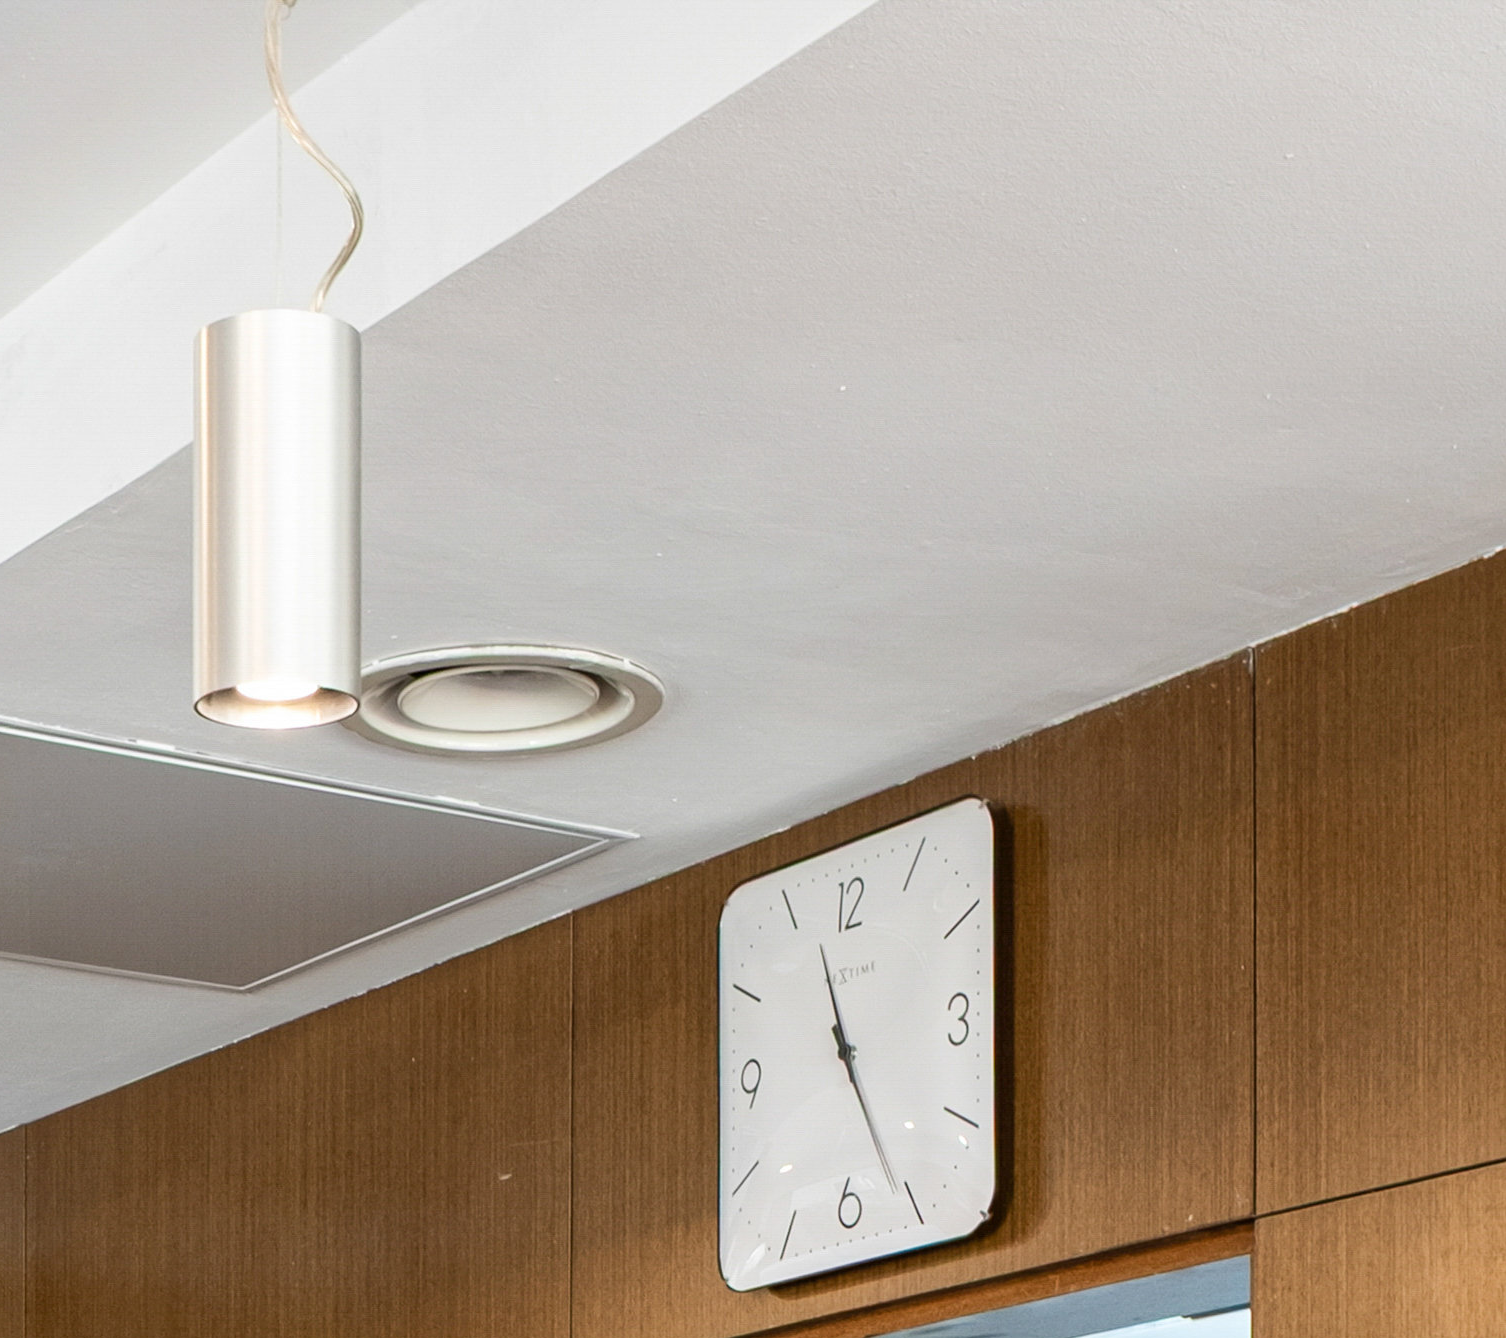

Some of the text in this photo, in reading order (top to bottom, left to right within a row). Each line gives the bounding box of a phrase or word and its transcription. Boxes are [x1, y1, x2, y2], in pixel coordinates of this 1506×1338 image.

[837, 877, 865, 933] 12
[947, 993, 970, 1046] 3
[741, 1059, 762, 1109] 9
[838, 1177, 862, 1229] 6
